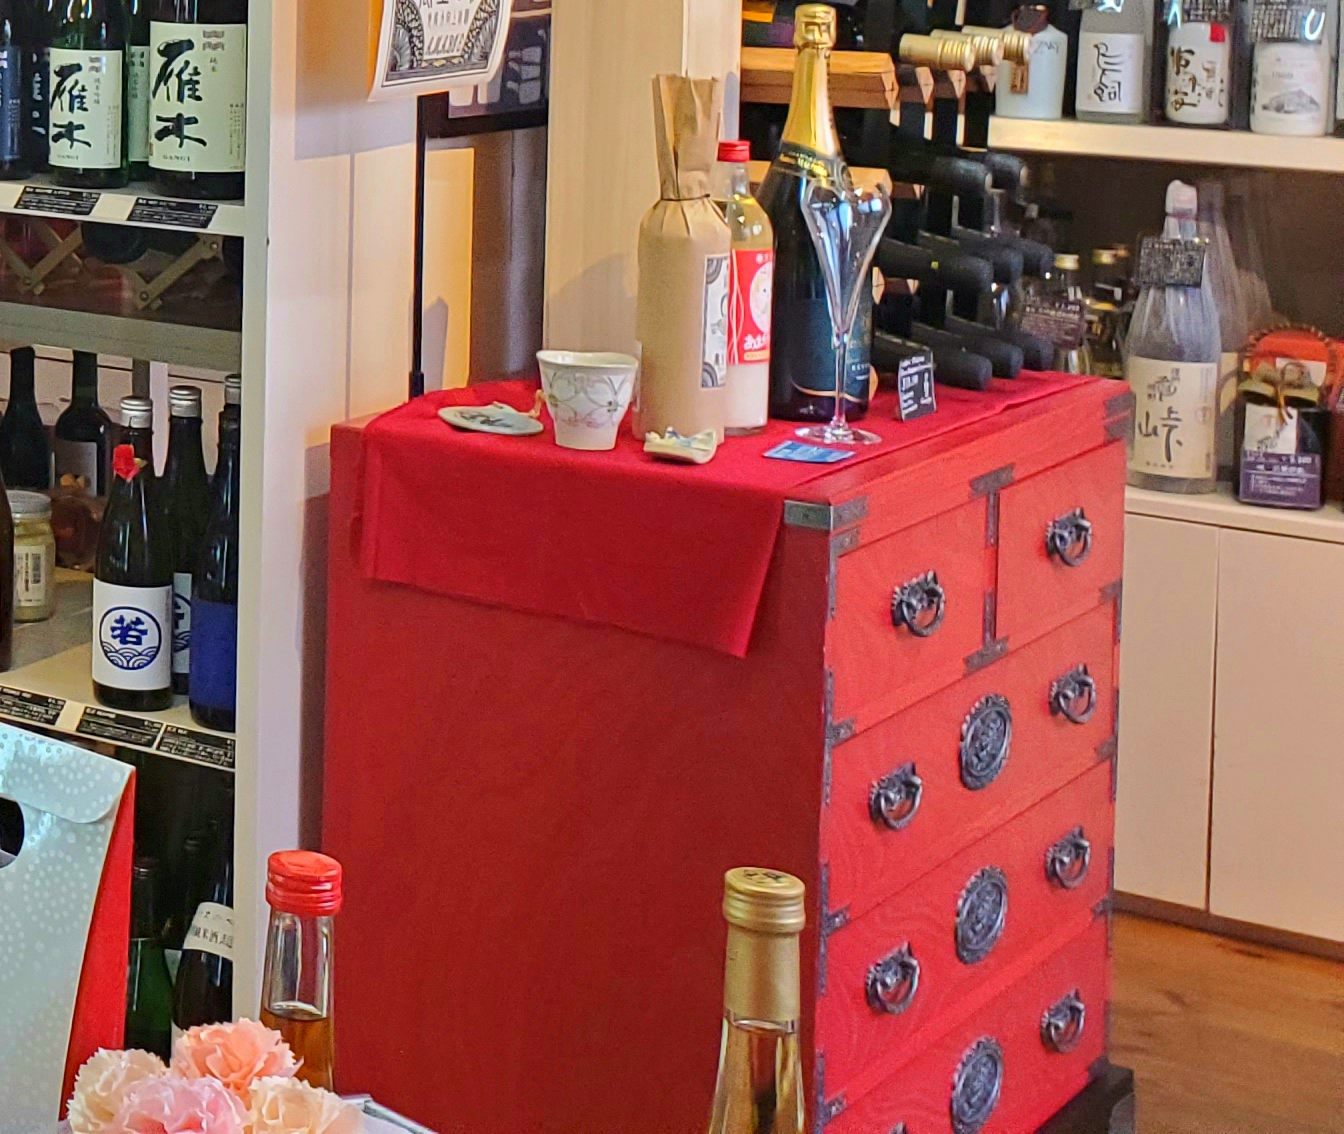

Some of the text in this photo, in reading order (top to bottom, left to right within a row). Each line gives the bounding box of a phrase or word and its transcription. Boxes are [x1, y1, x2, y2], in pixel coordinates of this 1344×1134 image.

[49, 62, 92, 150] 雁木
[151, 38, 208, 150] 雁木
[110, 618, 149, 647] 若
